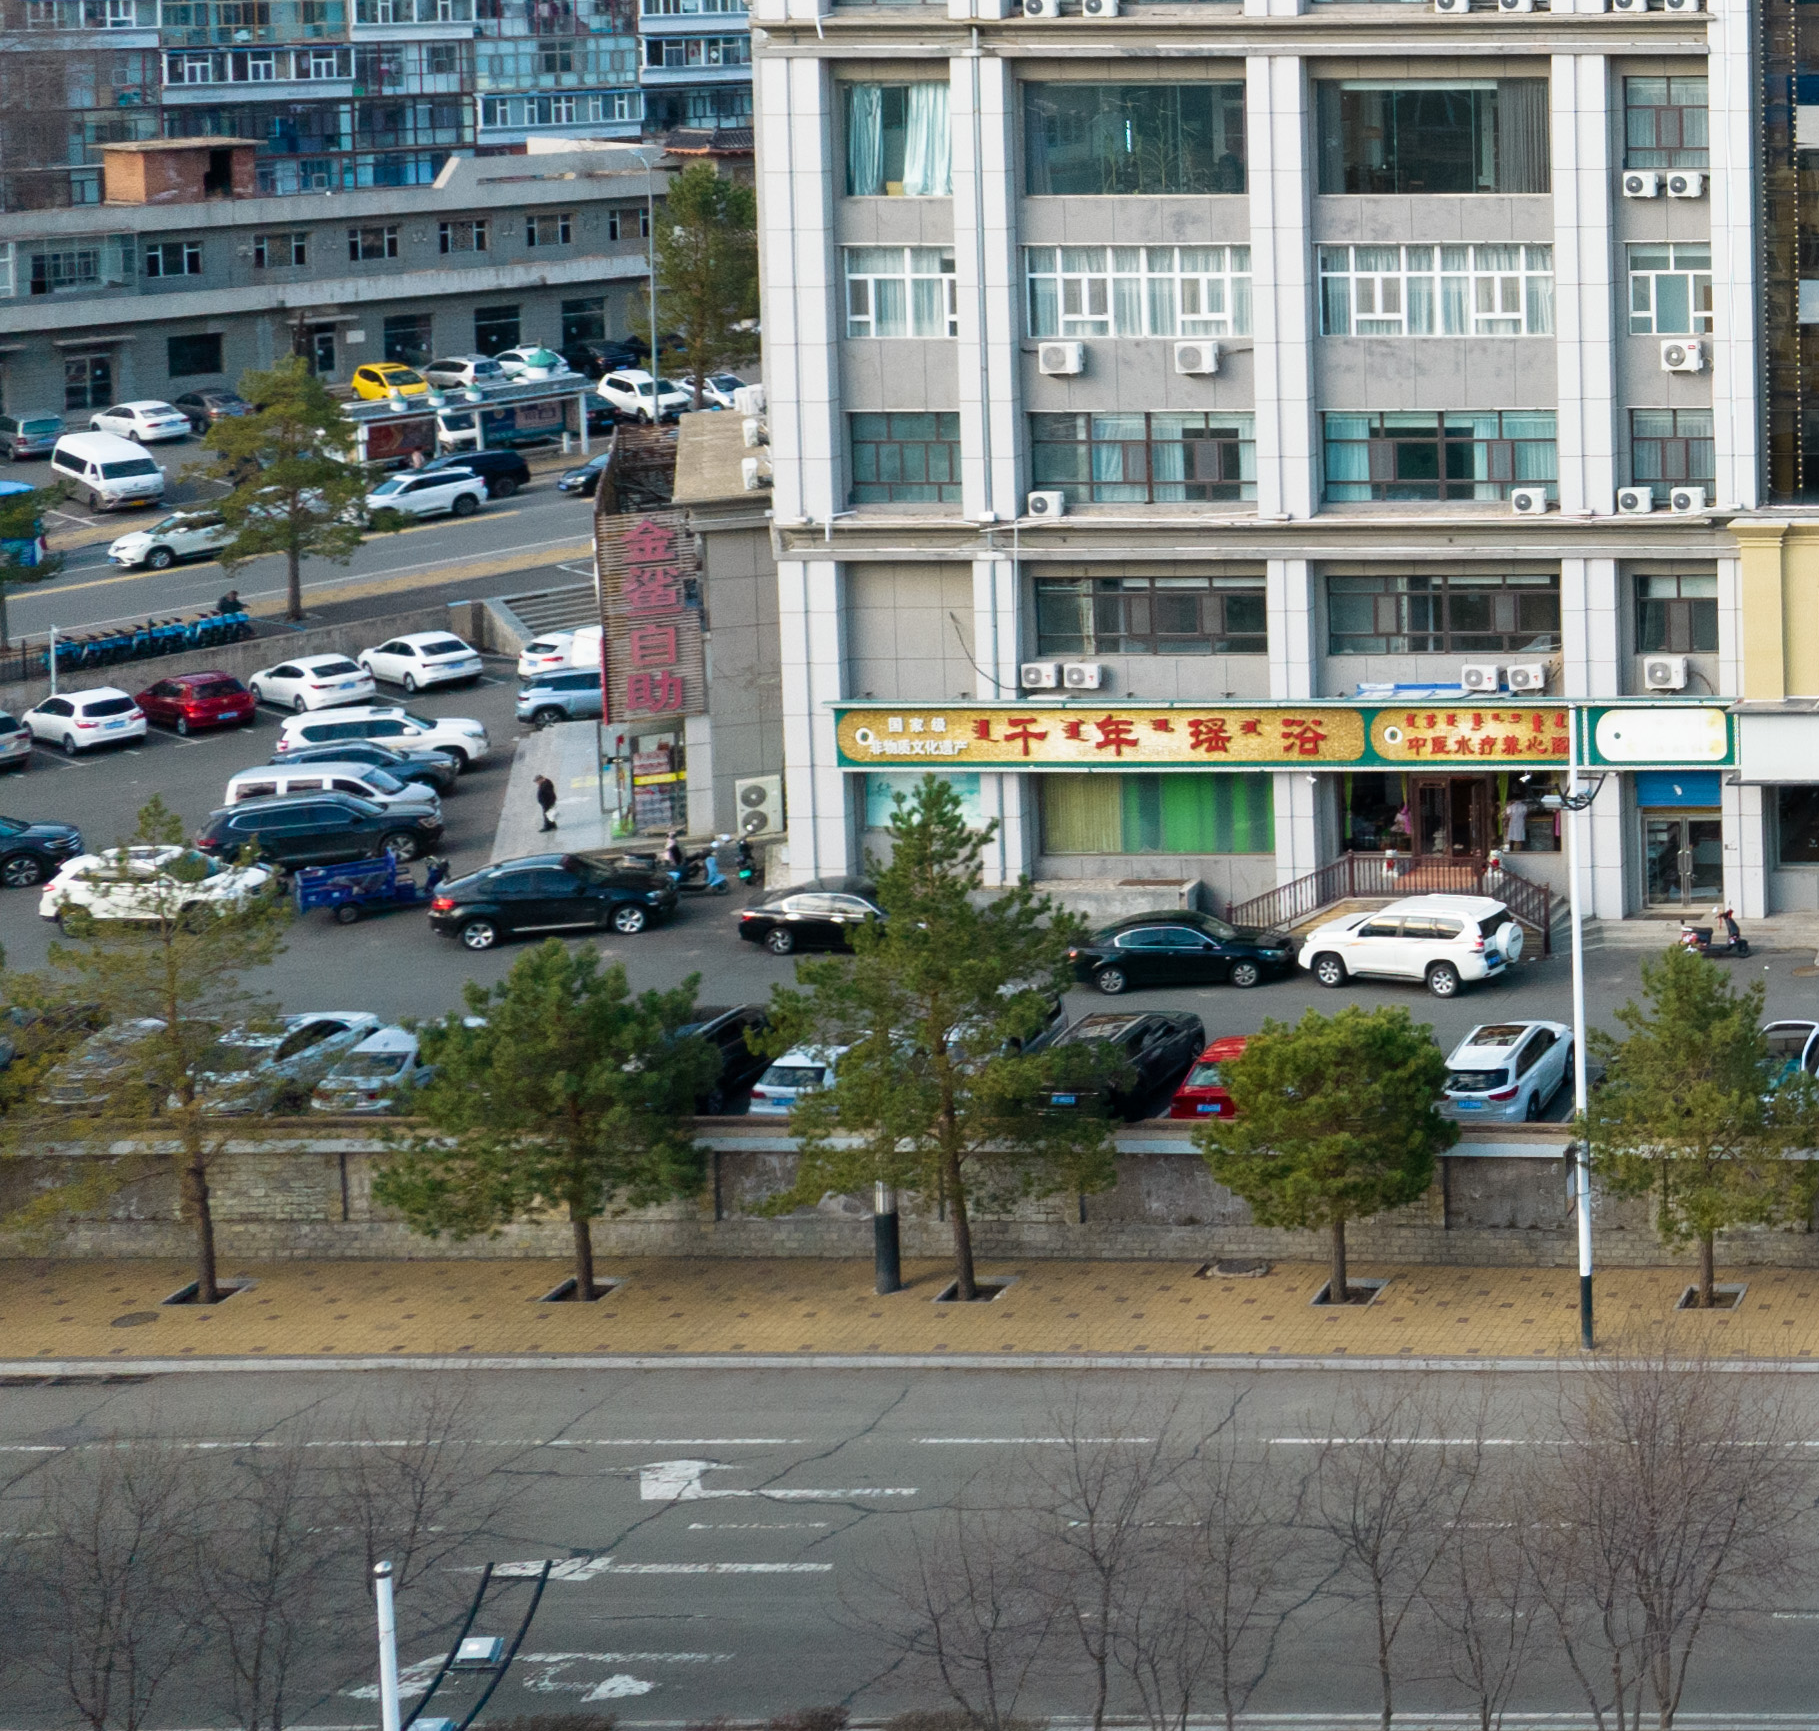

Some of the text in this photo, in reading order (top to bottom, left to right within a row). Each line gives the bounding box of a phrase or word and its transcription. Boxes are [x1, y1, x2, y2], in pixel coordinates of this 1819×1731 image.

[621, 519, 684, 714] 金鲨自助
[888, 716, 948, 733] 国家级
[1003, 713, 1328, 758] 千年瑶浴
[870, 739, 969, 756] 非物质文化遗产
